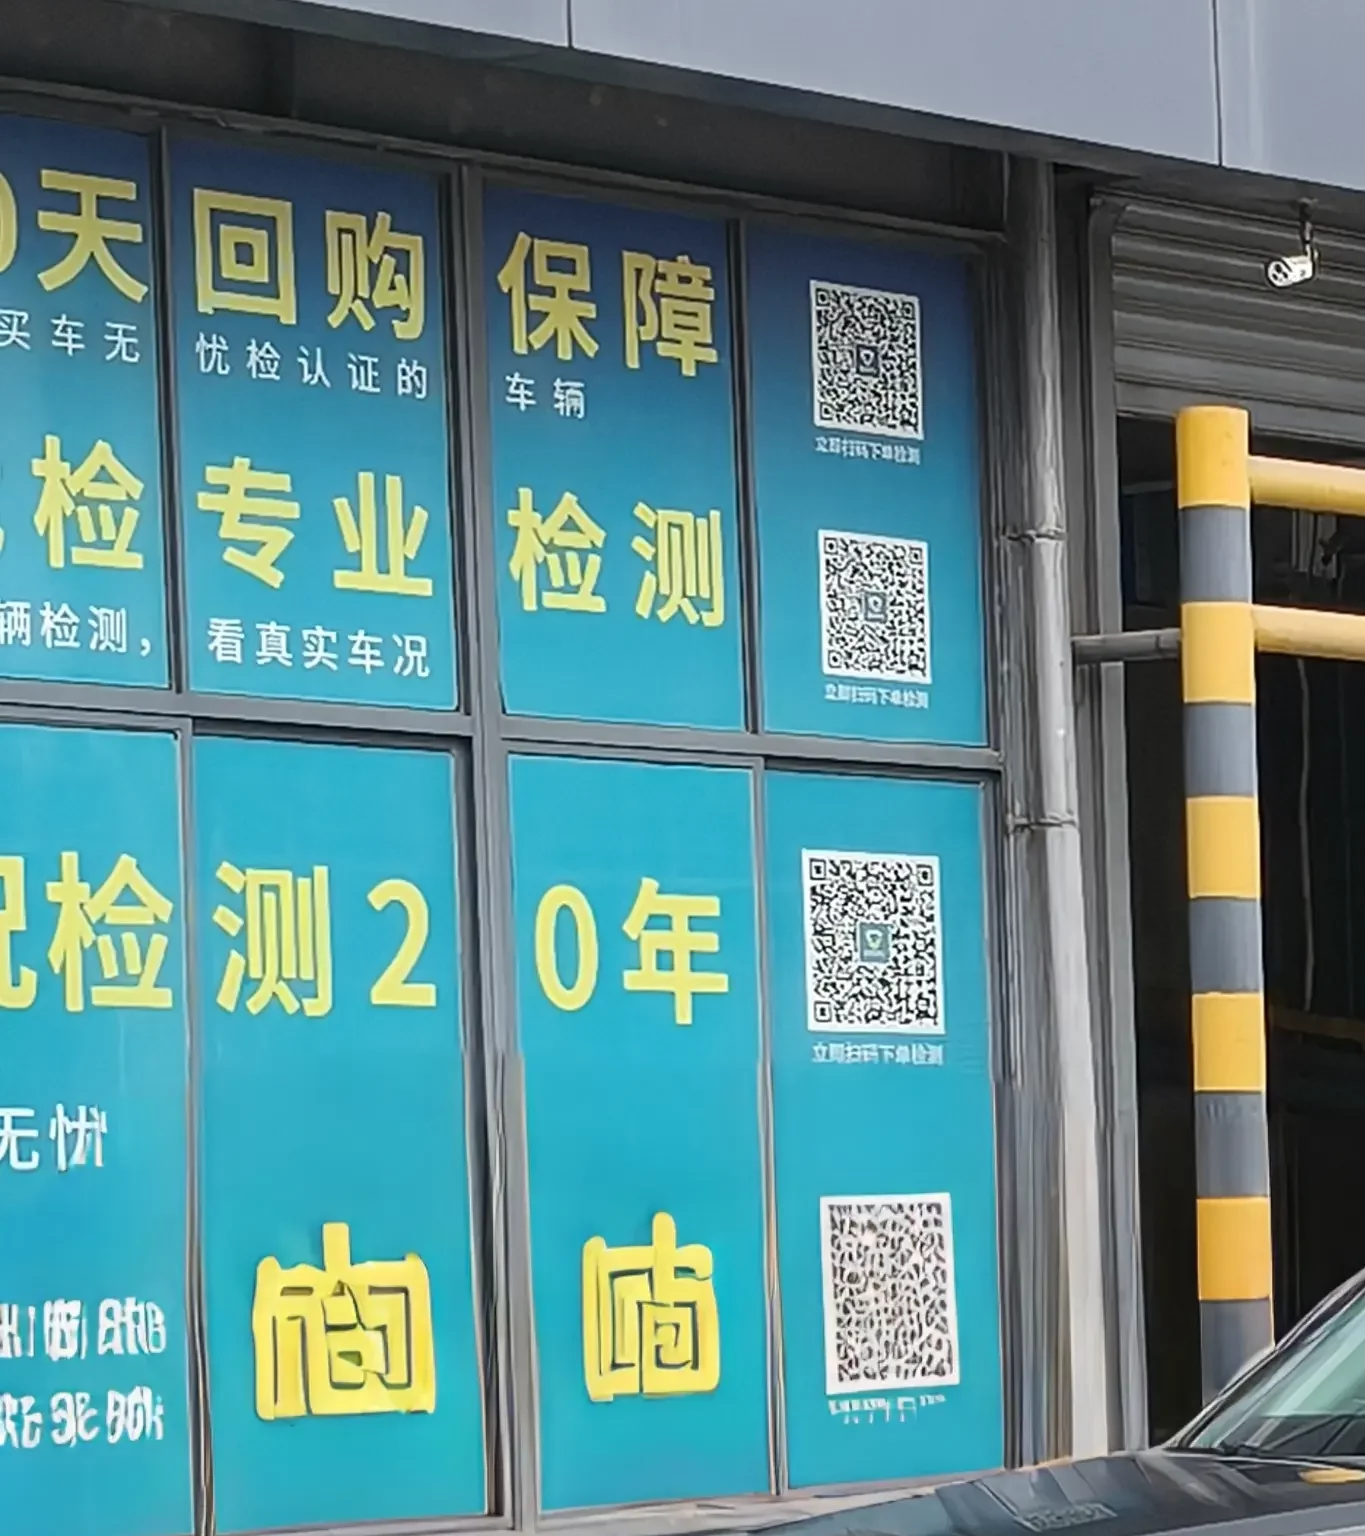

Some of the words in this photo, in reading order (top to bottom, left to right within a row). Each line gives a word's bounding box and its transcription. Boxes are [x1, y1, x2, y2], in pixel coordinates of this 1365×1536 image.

[207, 617, 430, 678] 看真实车况
